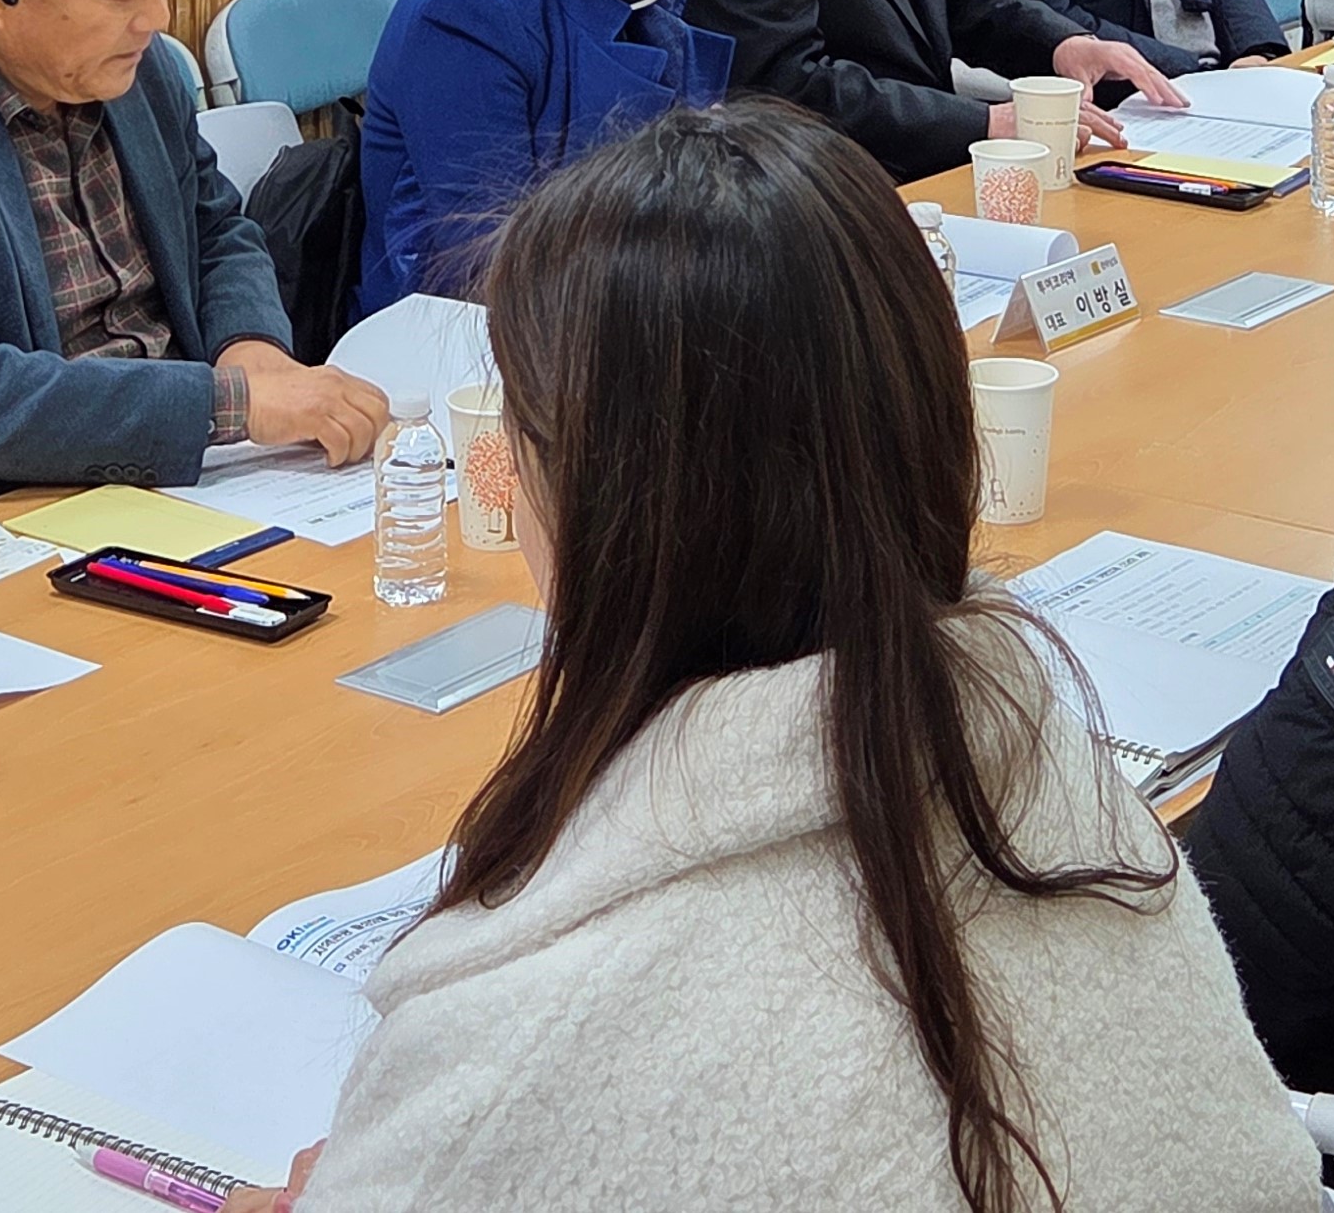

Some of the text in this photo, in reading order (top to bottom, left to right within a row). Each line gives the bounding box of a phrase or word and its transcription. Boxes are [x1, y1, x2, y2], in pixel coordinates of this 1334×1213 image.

[1036, 269, 1077, 294] 투어코리아
[1076, 278, 1132, 318] 이방실
[1044, 312, 1067, 331] 대표
